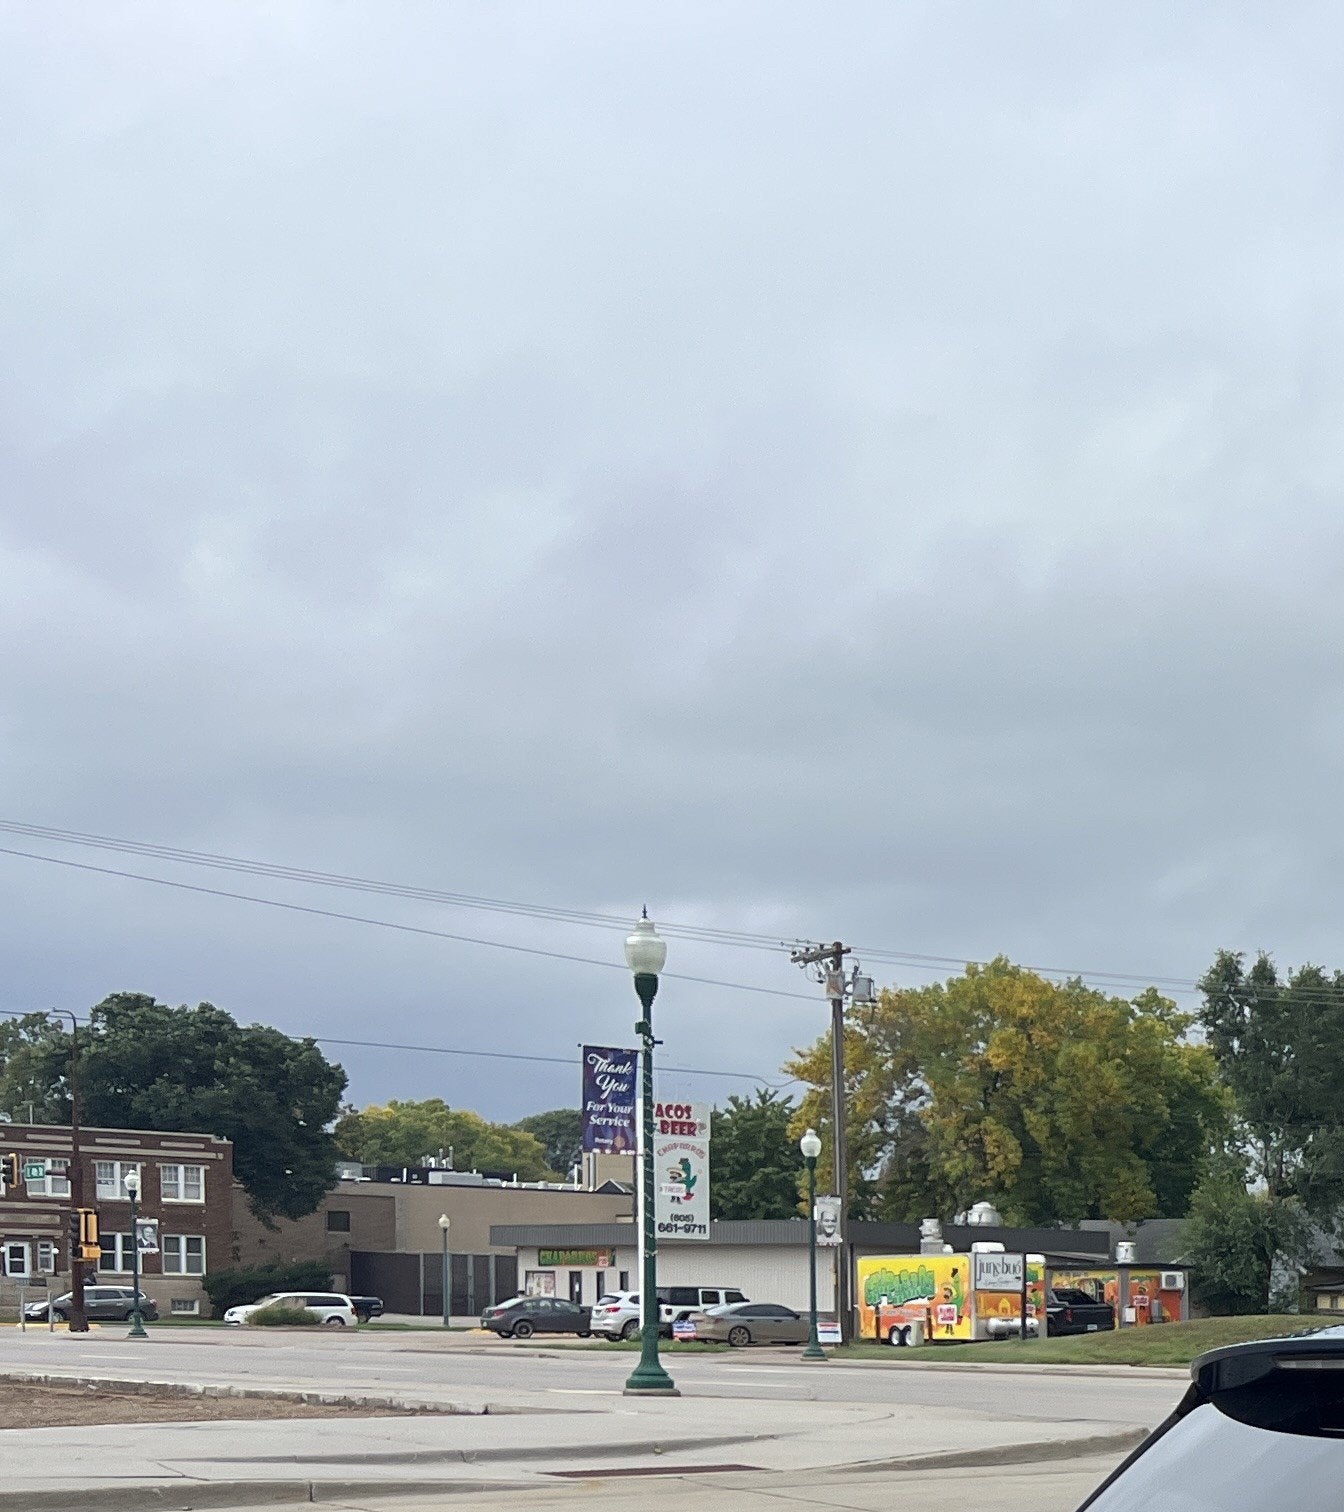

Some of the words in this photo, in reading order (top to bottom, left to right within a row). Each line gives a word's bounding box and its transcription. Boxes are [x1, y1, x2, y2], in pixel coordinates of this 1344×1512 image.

[587, 1053, 633, 1075] Thank
[596, 1074, 630, 1099] You
[587, 1101, 605, 1112] For
[607, 1102, 633, 1114] Your
[653, 1103, 692, 1119] ACOS
[589, 1114, 630, 1127] Service
[660, 1120, 697, 1136] BEER
[657, 1223, 706, 1234] 661-9711
